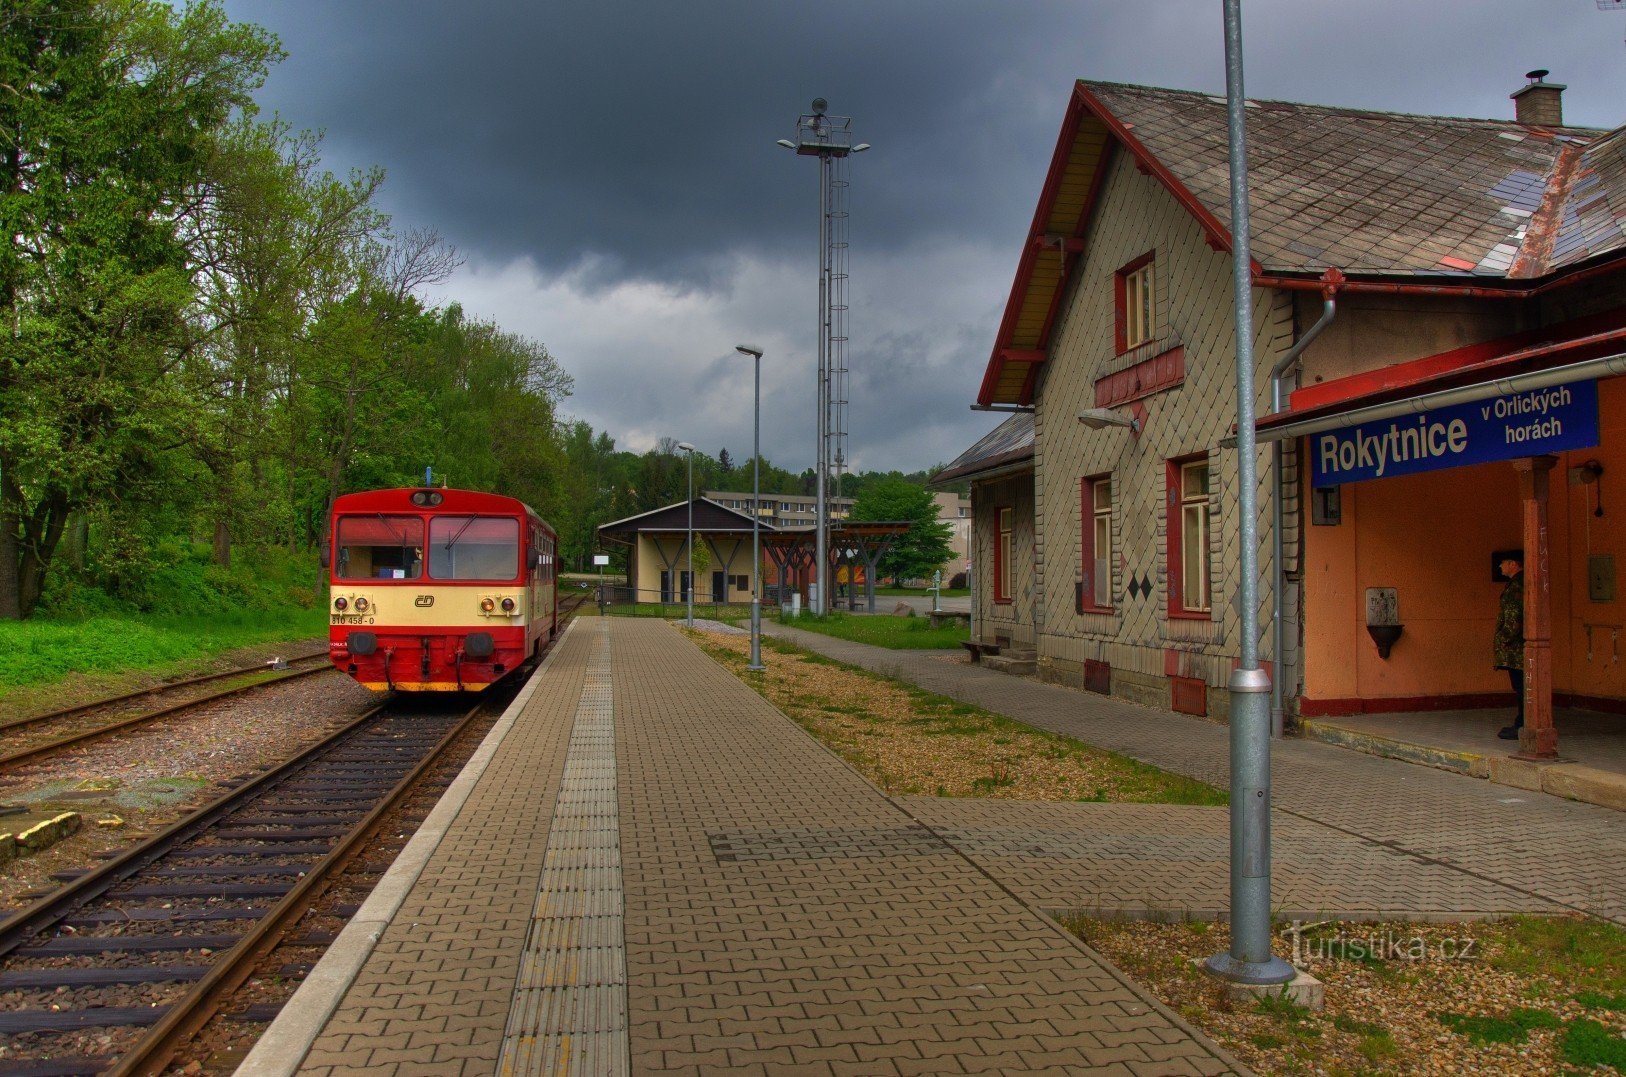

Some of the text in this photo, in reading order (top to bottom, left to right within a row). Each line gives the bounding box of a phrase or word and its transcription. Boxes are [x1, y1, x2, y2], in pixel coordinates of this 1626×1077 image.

[1481, 386, 1571, 421] v Orlických
[1320, 415, 1468, 476] Rokytnice
[1505, 417, 1562, 444] horách
